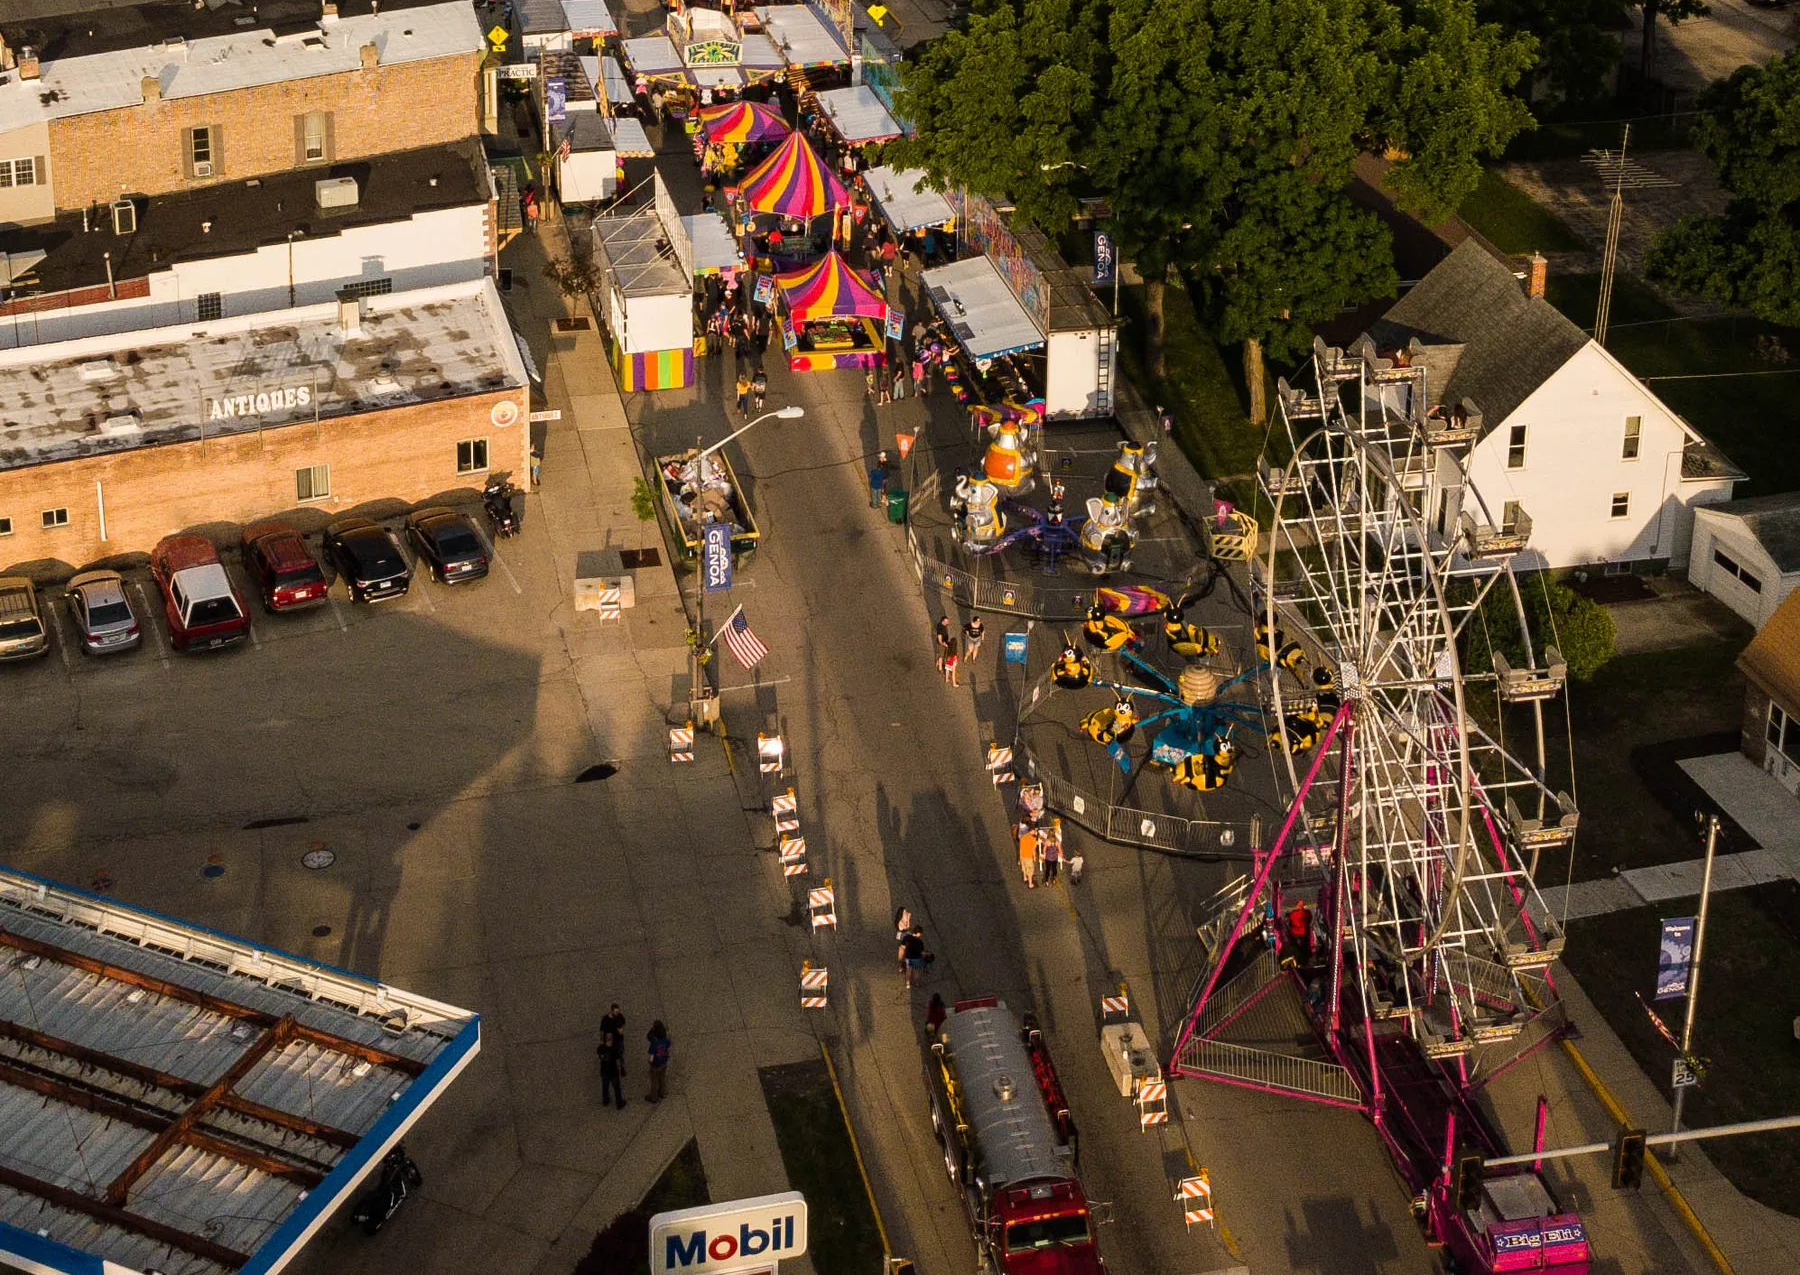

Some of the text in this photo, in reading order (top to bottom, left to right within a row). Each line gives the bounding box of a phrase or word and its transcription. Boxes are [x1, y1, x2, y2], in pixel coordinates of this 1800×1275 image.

[1097, 235, 1106, 279] GENOA
[210, 386, 311, 420] ANTIQUES
[709, 530, 720, 587] GENOA
[1657, 984, 1685, 994] GENOA
[1675, 1073, 1695, 1085] 25
[666, 1215, 794, 1270] Mobil
[1504, 1229, 1575, 1248] Big Eli
